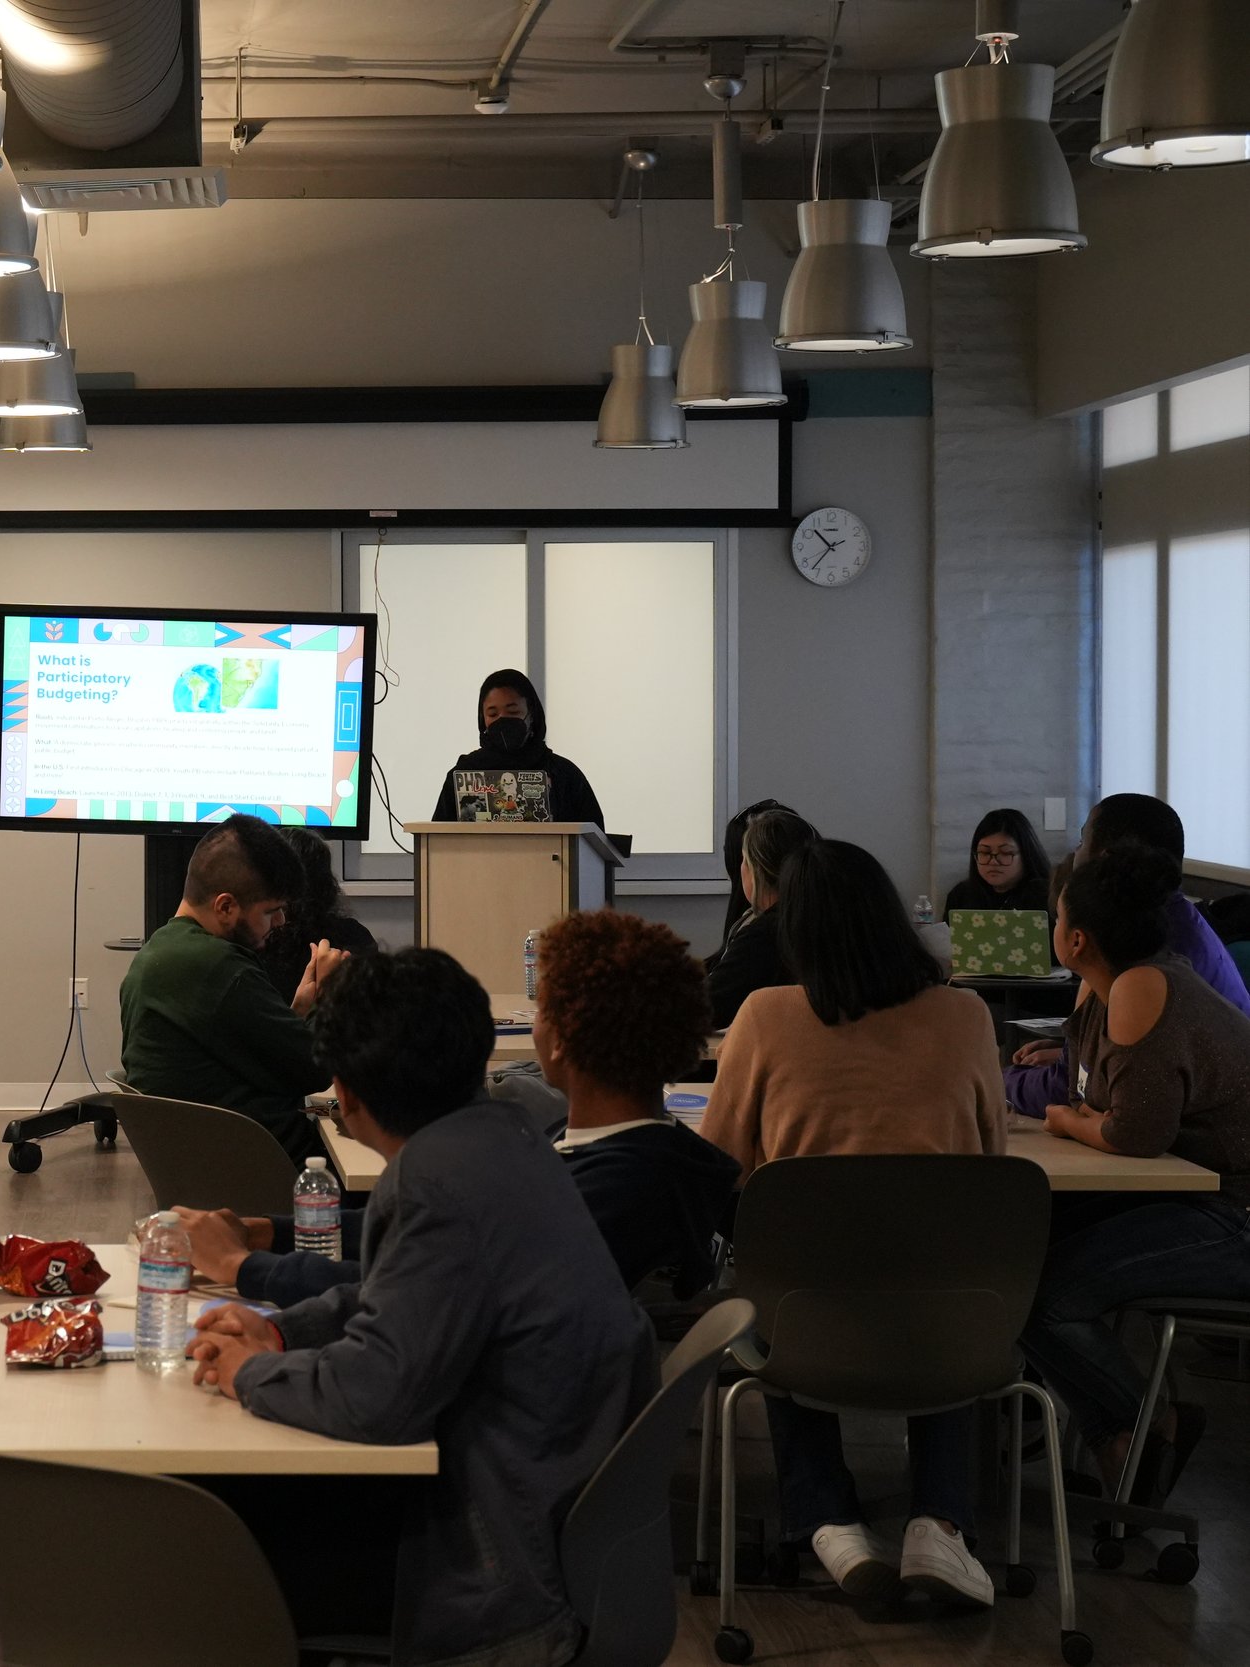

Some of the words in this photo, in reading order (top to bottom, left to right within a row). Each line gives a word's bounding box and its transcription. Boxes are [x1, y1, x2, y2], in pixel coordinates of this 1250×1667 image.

[812, 517, 821, 527] 11
[826, 511, 837, 523] 12
[802, 528, 814, 539] 10
[853, 526, 861, 537] 2
[796, 543, 804, 552] 9
[858, 541, 866, 552] 3
[801, 558, 809, 568] 8
[853, 556, 861, 566] 4
[814, 567, 821, 578] 7
[827, 571, 835, 582] 6
[842, 567, 850, 578] 5
[37, 654, 76, 666] What
[79, 654, 91, 667] is
[37, 671, 131, 687] Participatory
[36, 687, 118, 704] Budgeting?
